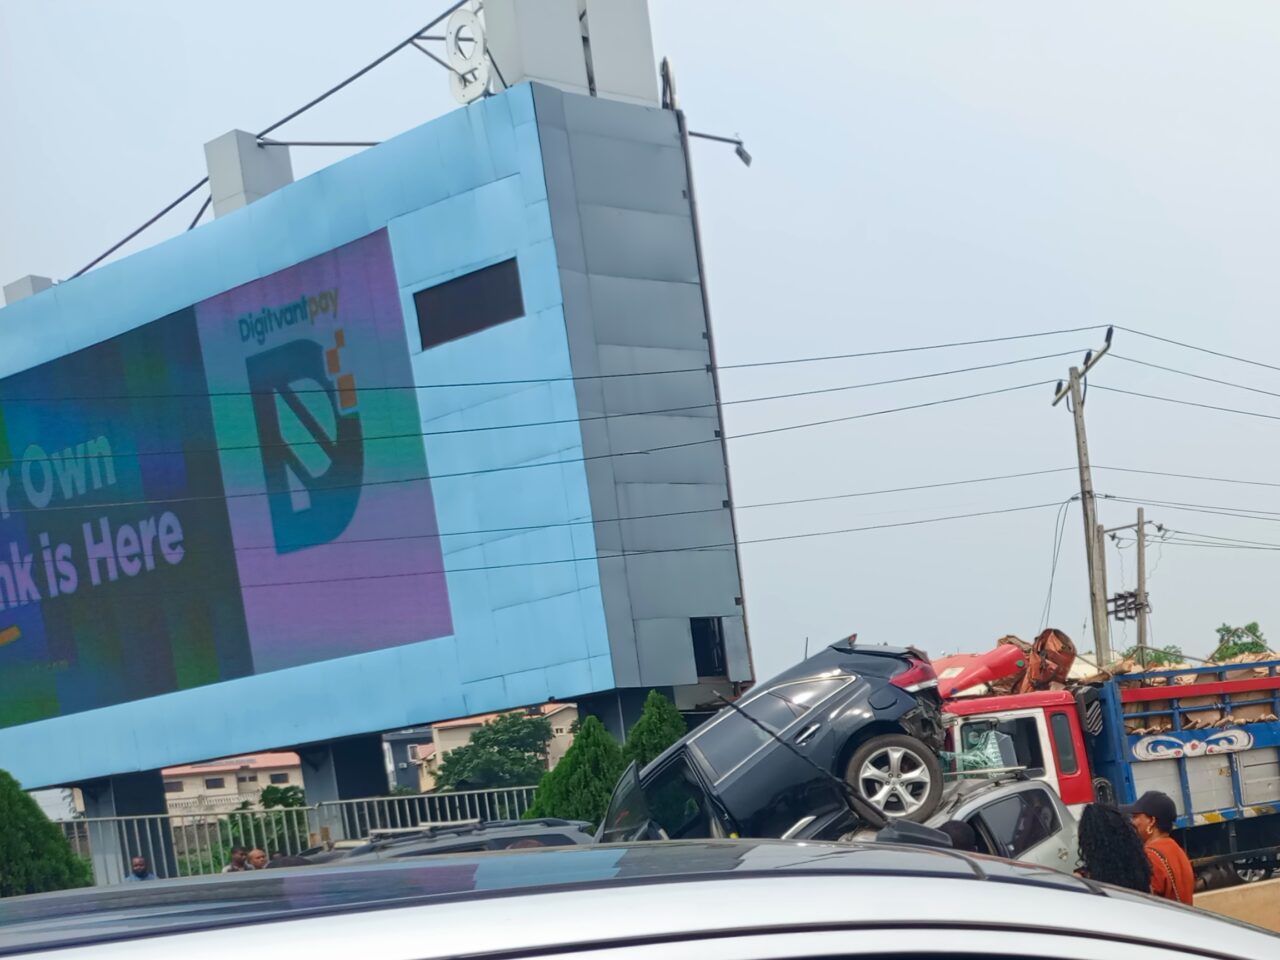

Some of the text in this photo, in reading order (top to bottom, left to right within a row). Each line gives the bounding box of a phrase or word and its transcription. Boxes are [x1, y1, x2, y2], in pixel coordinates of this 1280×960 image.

[21, 435, 117, 509] Own
[39, 532, 78, 598] is
[82, 511, 185, 587] Here
